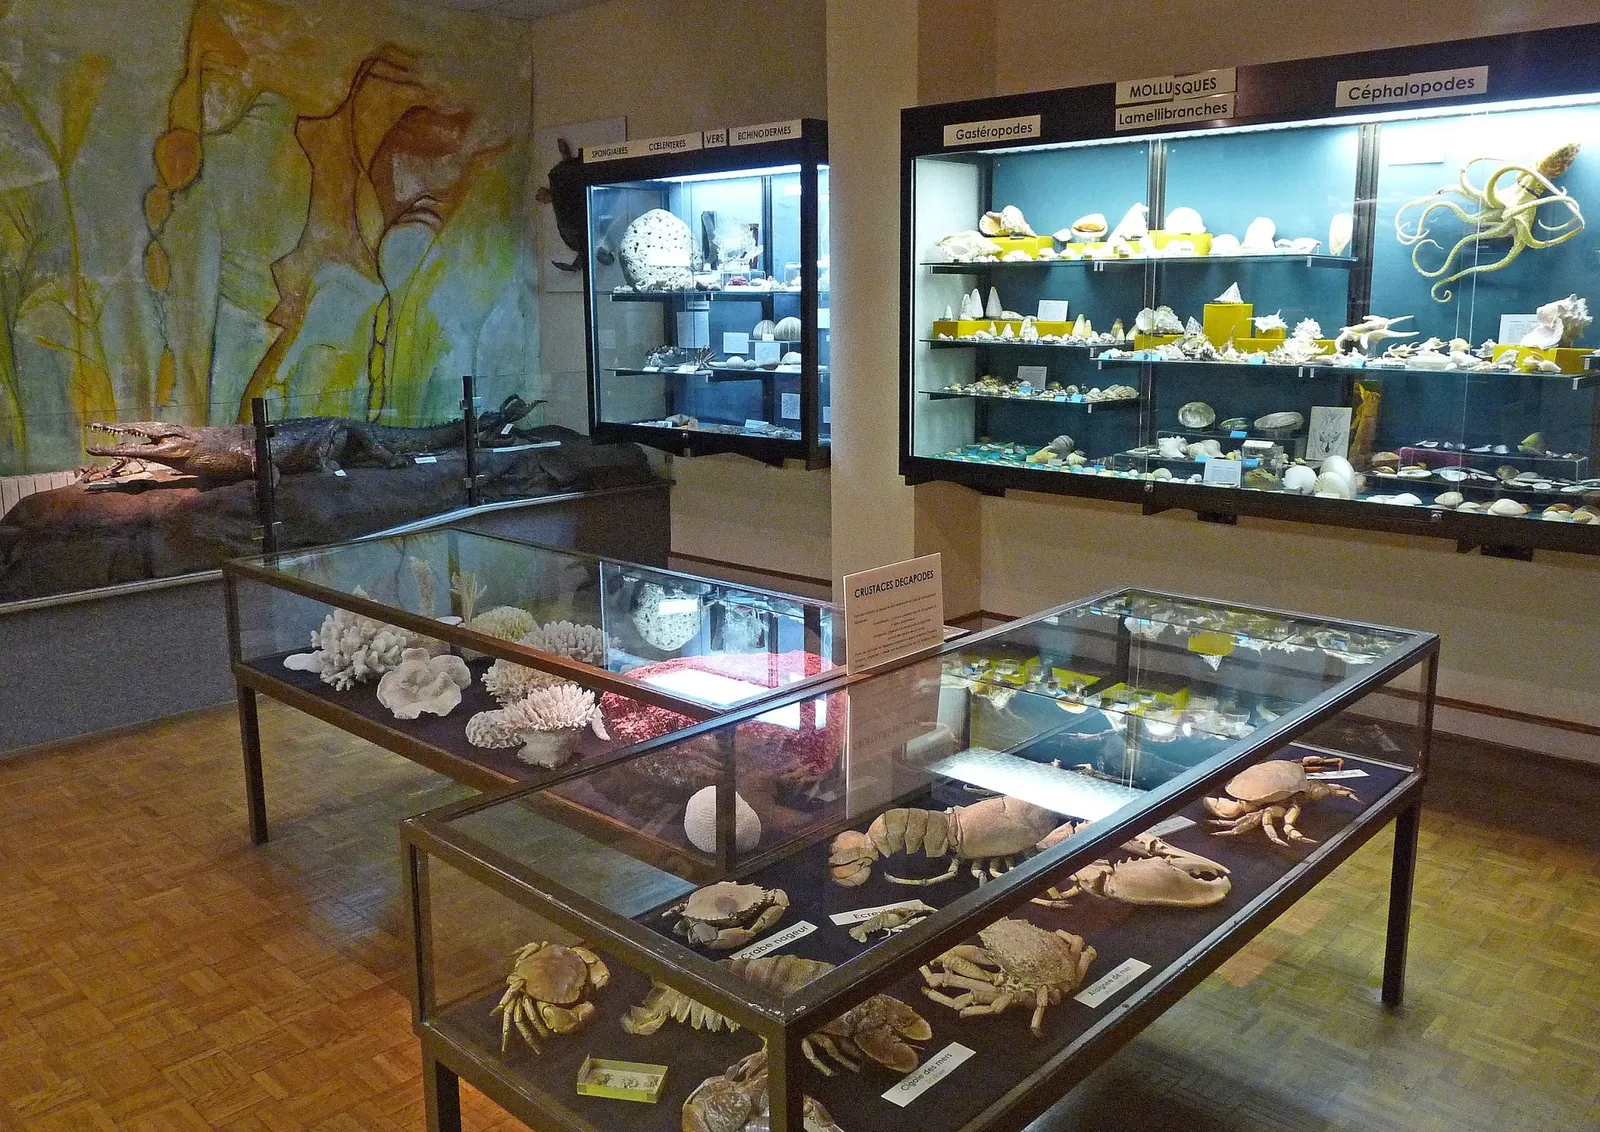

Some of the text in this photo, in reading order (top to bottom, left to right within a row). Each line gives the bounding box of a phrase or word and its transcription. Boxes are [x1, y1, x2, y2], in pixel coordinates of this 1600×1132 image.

[1129, 77, 1217, 98] MOLLUSQUES
[1349, 76, 1475, 101] Céphalopodes
[1119, 102, 1227, 125] Lamellibranches
[706, 133, 725, 144] VERS
[737, 126, 792, 140] ECHINODERMES
[955, 122, 1033, 141] Gastéropodes
[591, 146, 628, 158] SPONGIAIRES
[854, 570, 934, 598] CRUSTACES DECAPODES
[740, 924, 809, 960] Crabe nageur
[923, 1065, 937, 1075] des
